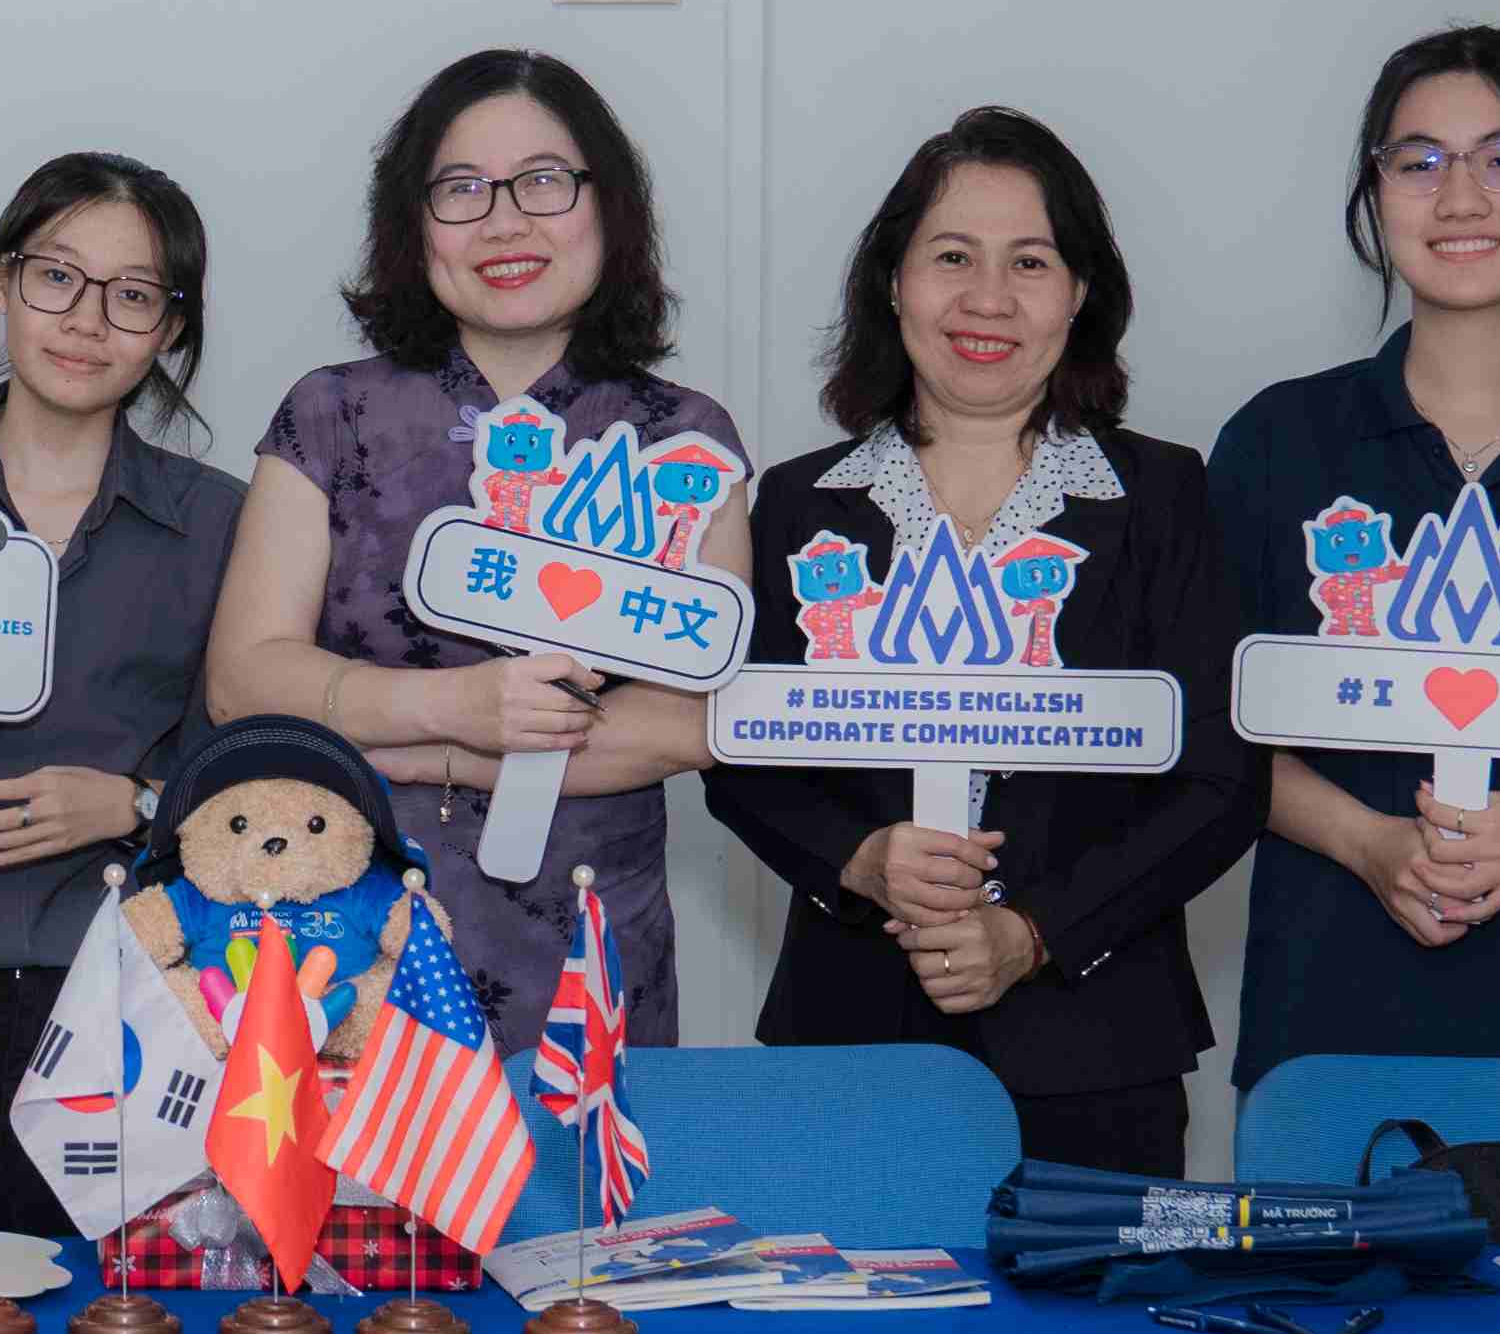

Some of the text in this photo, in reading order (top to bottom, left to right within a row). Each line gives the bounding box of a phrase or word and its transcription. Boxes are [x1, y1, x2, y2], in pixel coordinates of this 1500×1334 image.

[466, 546, 718, 650] 我 中文
[812, 688, 952, 713] BUSINESS
[958, 690, 1083, 714] ENGLISH
[733, 719, 1145, 749] CORPORATE COMMUNICATION
